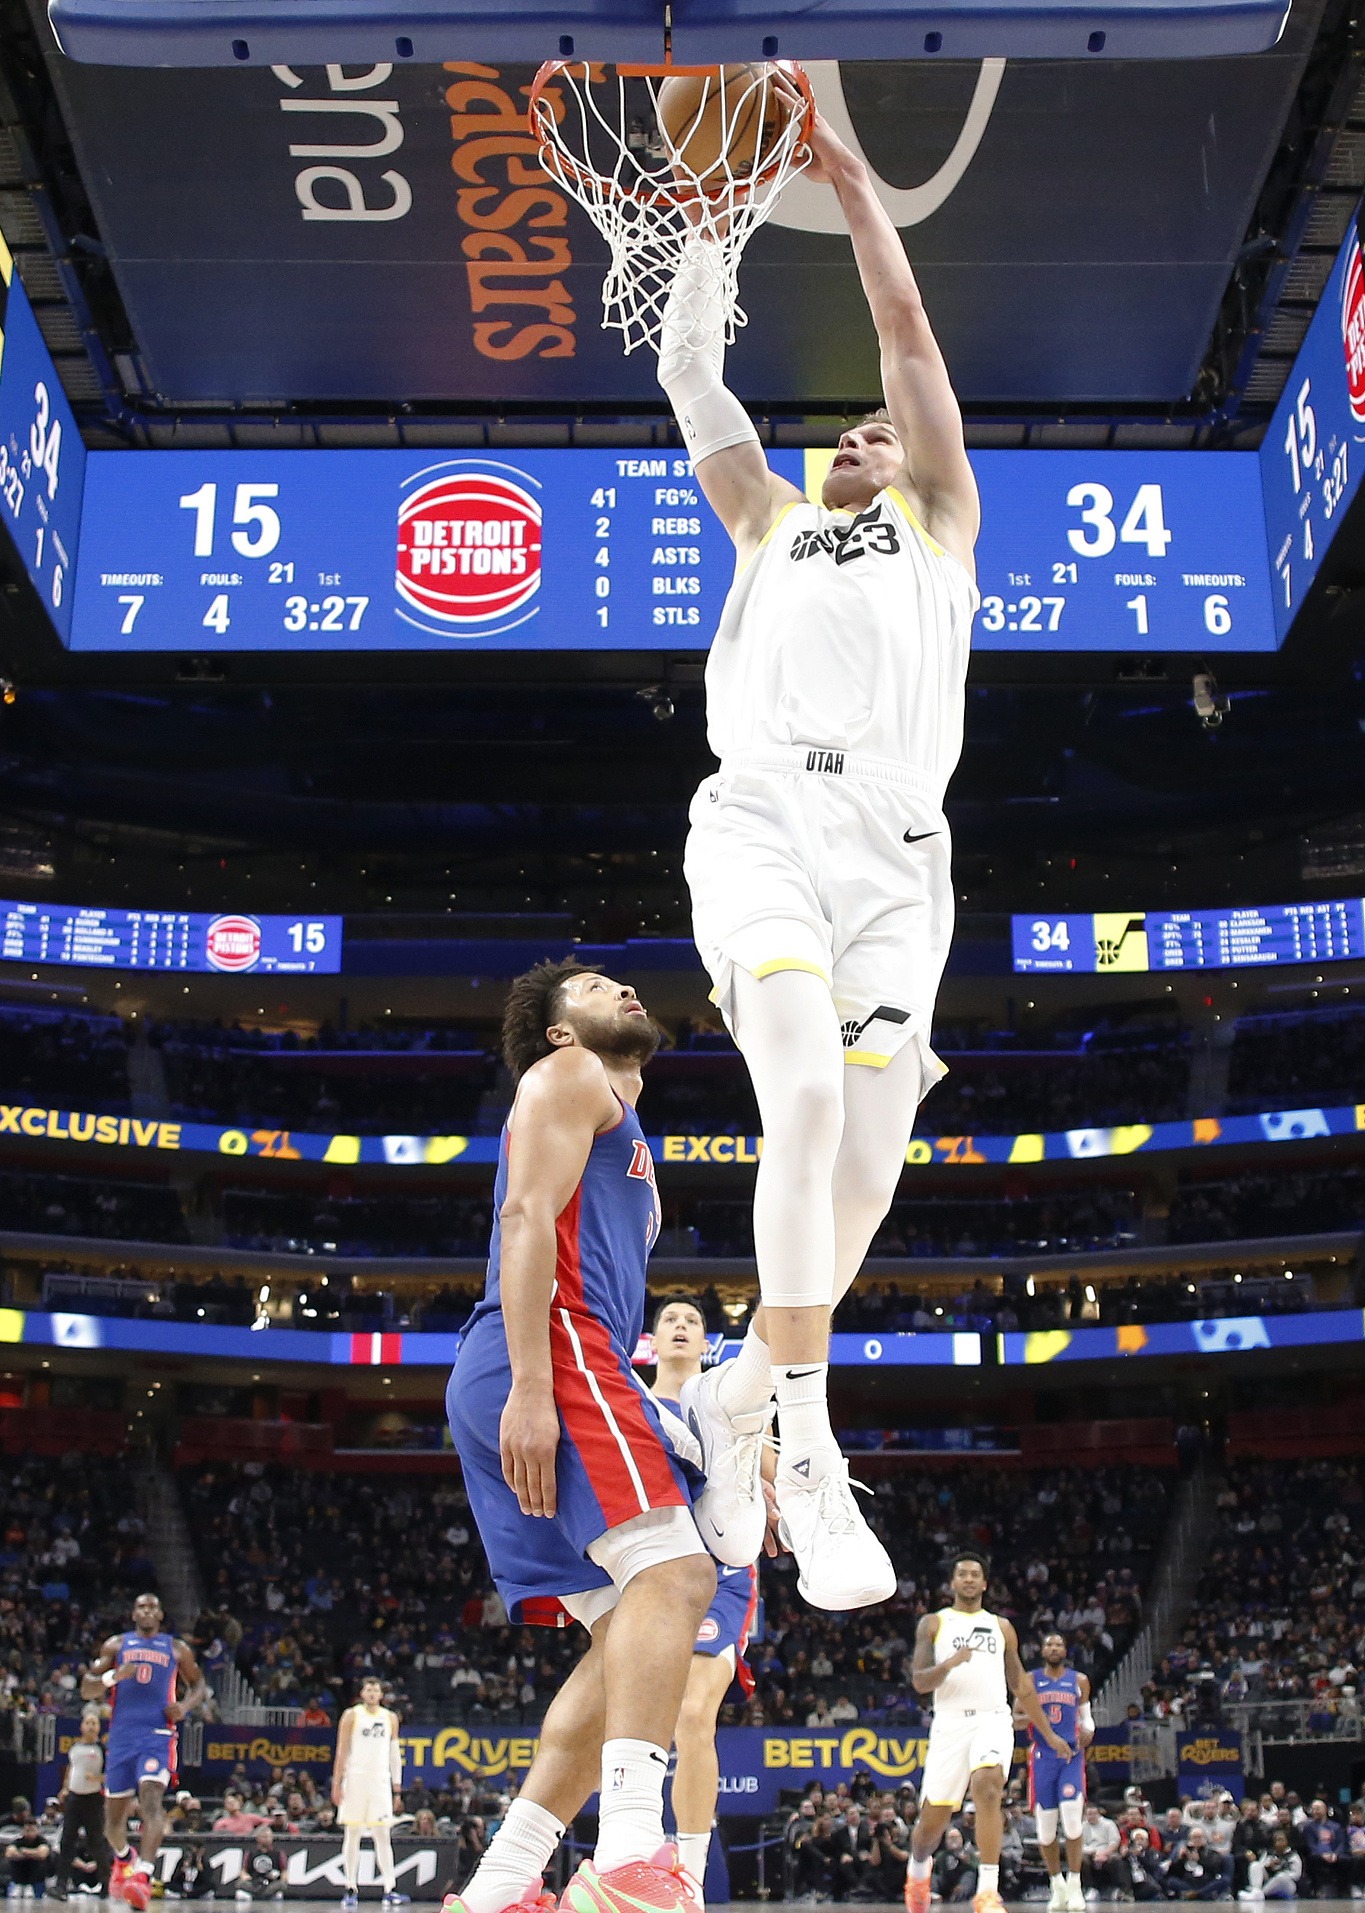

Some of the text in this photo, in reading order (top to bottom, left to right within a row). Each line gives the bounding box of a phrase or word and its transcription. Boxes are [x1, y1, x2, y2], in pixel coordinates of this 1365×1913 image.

[443, 62, 581, 360] aesars
[30, 381, 62, 500] 34
[1284, 377, 1316, 494] 15
[616, 460, 697, 478] TEAM ST
[590, 487, 698, 509] 41 FG%
[179, 483, 281, 559] 15
[595, 517, 701, 538] 2 REBS
[1066, 482, 1172, 558] 34
[411, 520, 526, 547] DETROIT
[835, 522, 901, 566] 23
[410, 548, 527, 575] PISTONS
[595, 547, 701, 568] 4 ASTS
[101, 573, 243, 587] TIMEOUTS: FOULS:
[268, 562, 341, 587] 21 1st
[595, 576, 701, 598] 0 BLKS
[1008, 562, 1078, 587] 1st 21
[1114, 574, 1246, 588] FOULS: TIMEOUTS:
[118, 595, 370, 634] 7 4 3:27
[597, 606, 701, 628] 1 STLS
[981, 594, 1232, 635] 3:27 1 6
[806, 751, 845, 775] UTAH
[288, 922, 326, 953] 15
[1031, 920, 1071, 952] 34
[0, 1104, 182, 1150] XCLUSIVE
[973, 1634, 997, 1654] 28
[136, 1664, 152, 1685] 0
[1049, 1705, 1063, 1725] 5
